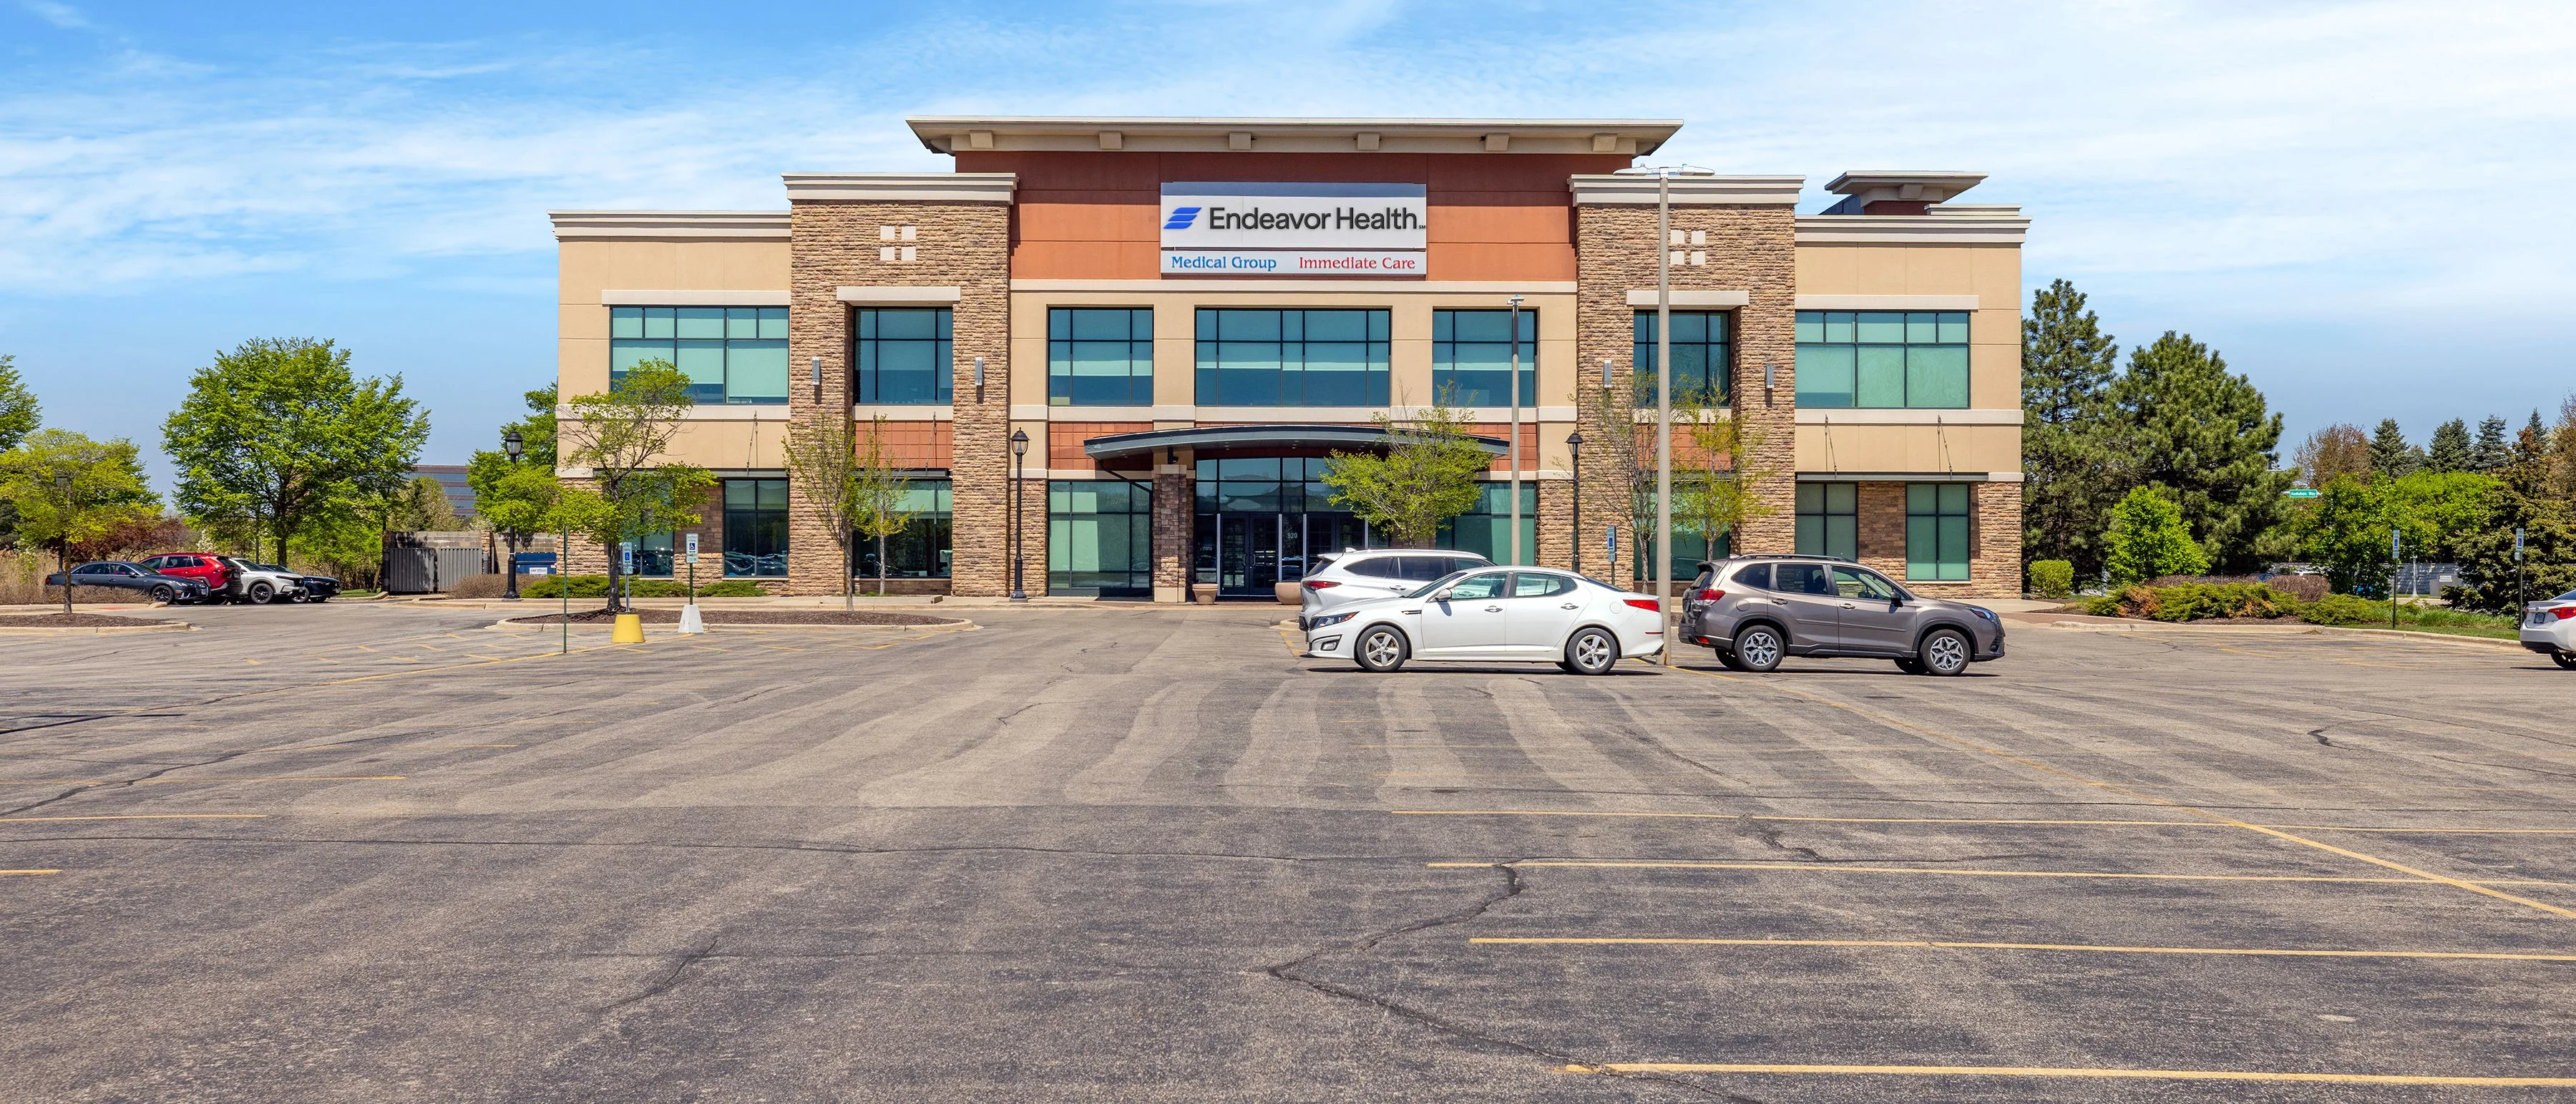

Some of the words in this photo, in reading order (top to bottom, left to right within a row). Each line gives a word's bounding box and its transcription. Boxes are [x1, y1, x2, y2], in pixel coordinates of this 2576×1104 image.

[1209, 207, 1331, 230] Endeavor
[1336, 207, 1417, 230] Health
[1171, 256, 1226, 269] Medical
[1231, 256, 1277, 271] Group
[1299, 257, 1377, 269] Immediate
[1382, 257, 1415, 270] Care
